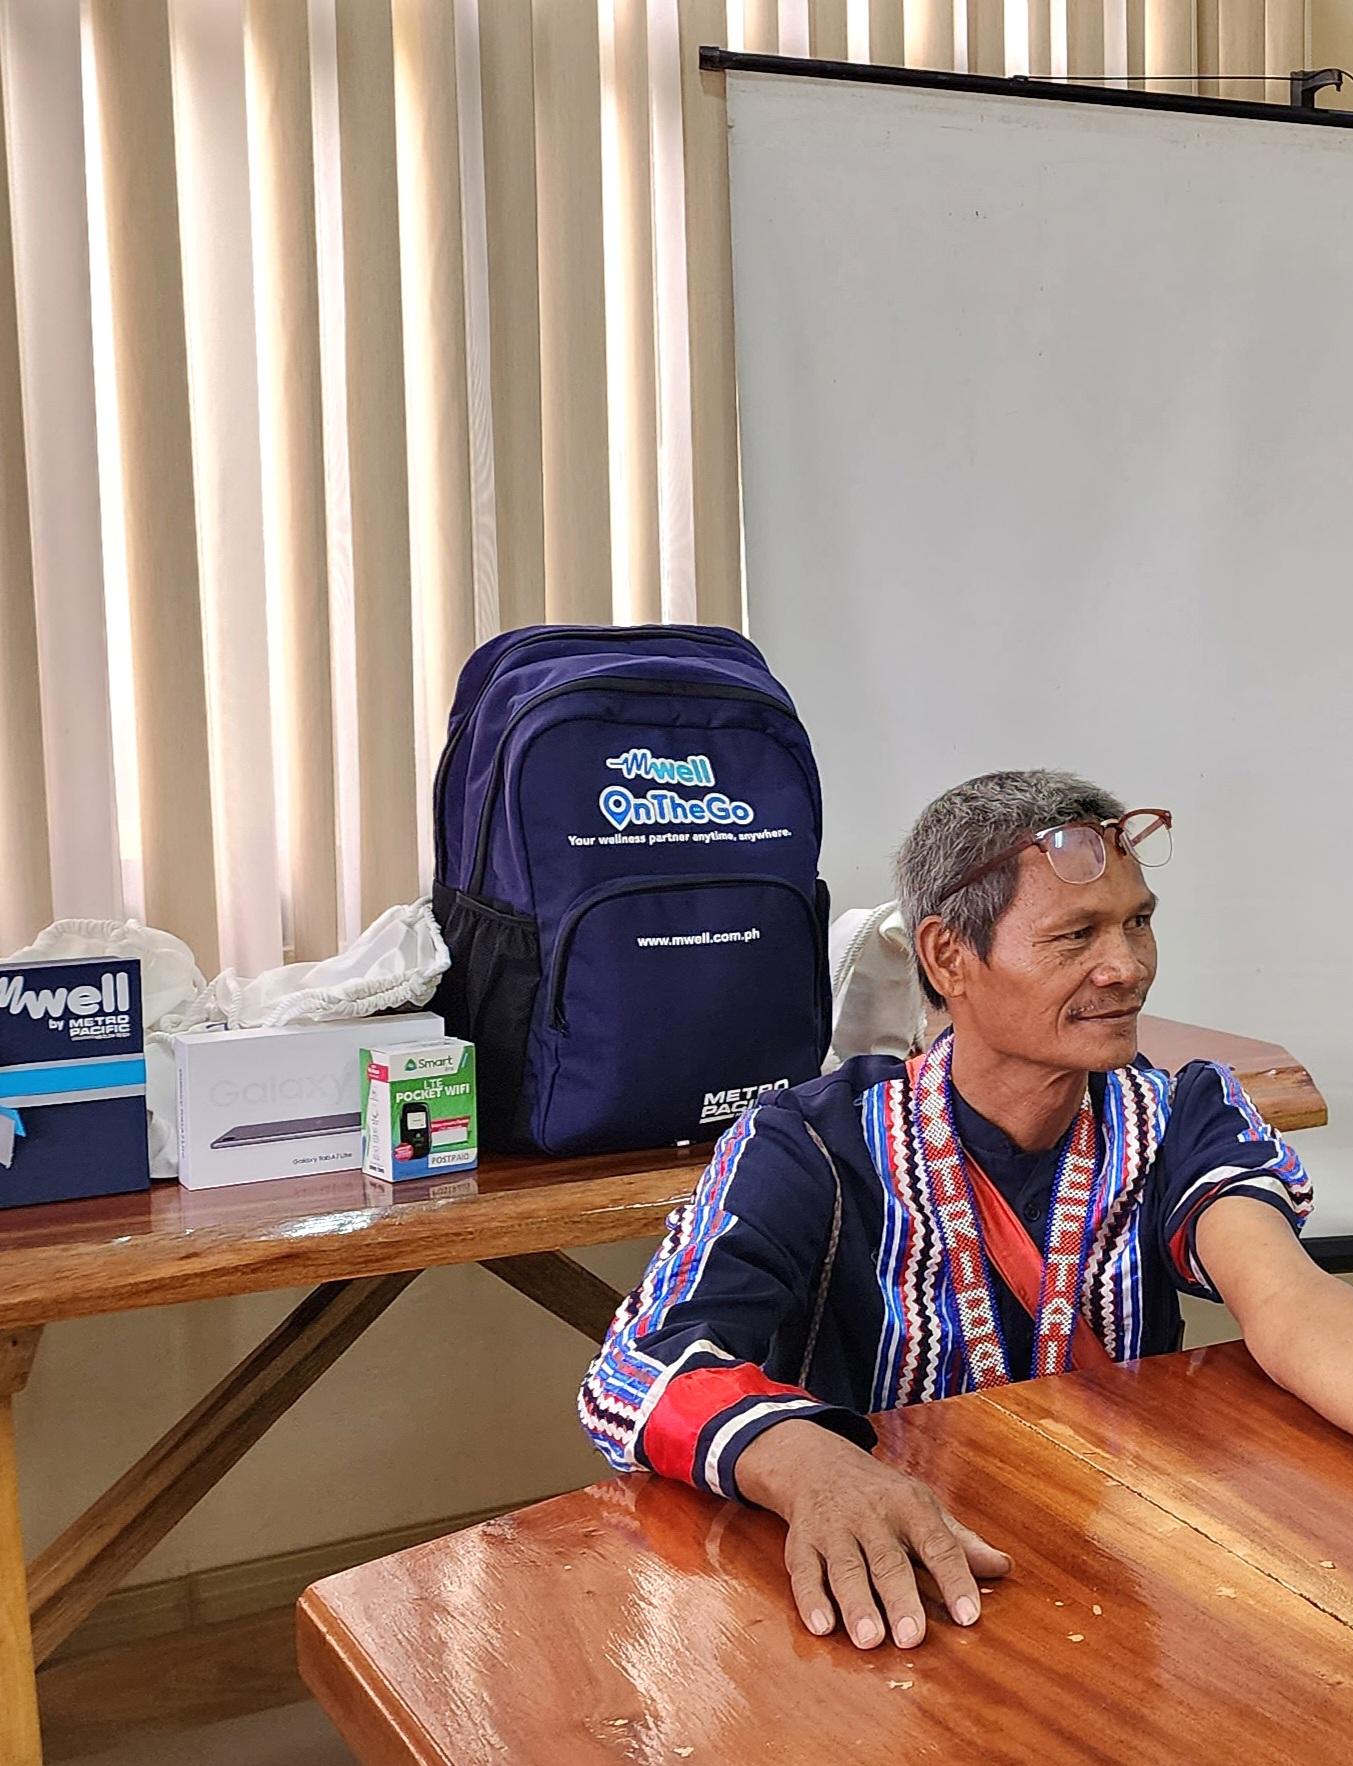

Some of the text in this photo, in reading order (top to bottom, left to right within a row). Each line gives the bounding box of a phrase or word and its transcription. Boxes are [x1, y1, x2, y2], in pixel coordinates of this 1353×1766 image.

[599, 786, 754, 831] OnTheGo
[568, 835, 596, 846] Your
[598, 834, 646, 845] wellness
[649, 833, 690, 846] partner
[637, 928, 760, 946] www.mwell.com.ph
[48, 1015, 130, 1031] by METRO
[70, 1024, 131, 1036] PACIFIC
[418, 1055, 454, 1069] Smart
[208, 1069, 348, 1107] Galaxy
[396, 1083, 471, 1103] POCKET WIFI
[424, 1078, 444, 1090] LTE
[703, 1079, 789, 1105] METRO
[700, 1098, 760, 1118] PACI
[431, 1153, 470, 1165] POSTPAID
[1037, 1117, 1096, 1374] IEFTAI
[927, 1154, 1006, 1382] TRIBA
